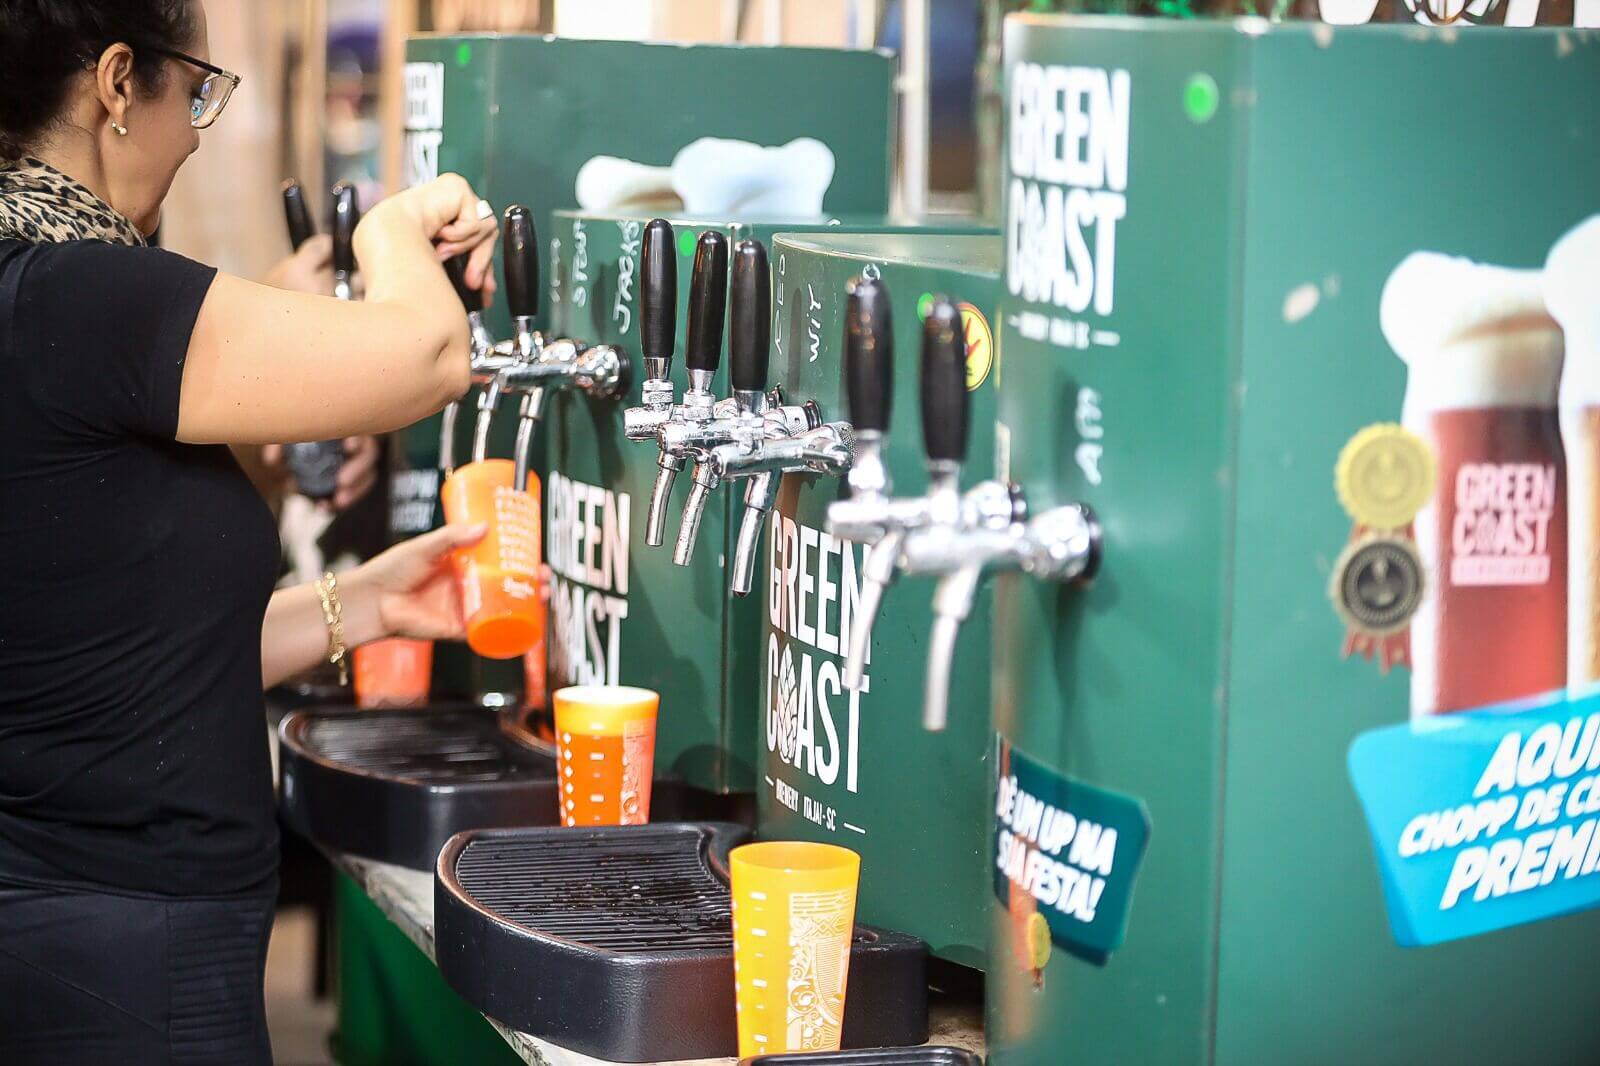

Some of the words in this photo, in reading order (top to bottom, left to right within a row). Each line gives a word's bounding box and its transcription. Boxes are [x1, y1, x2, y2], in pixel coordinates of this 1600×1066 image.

[1010, 62, 1131, 191] GREEN
[1007, 178, 1126, 316] COAST
[547, 469, 631, 595] GREEN
[1452, 508, 1553, 556] COAST
[1455, 464, 1556, 511] GREEN
[769, 509, 871, 665] GREEN
[766, 631, 870, 793] COAST
[1038, 805, 1077, 855] UP
[1068, 819, 1118, 877] NA
[1398, 794, 1499, 858] CHOPP
[1514, 781, 1569, 831] DE
